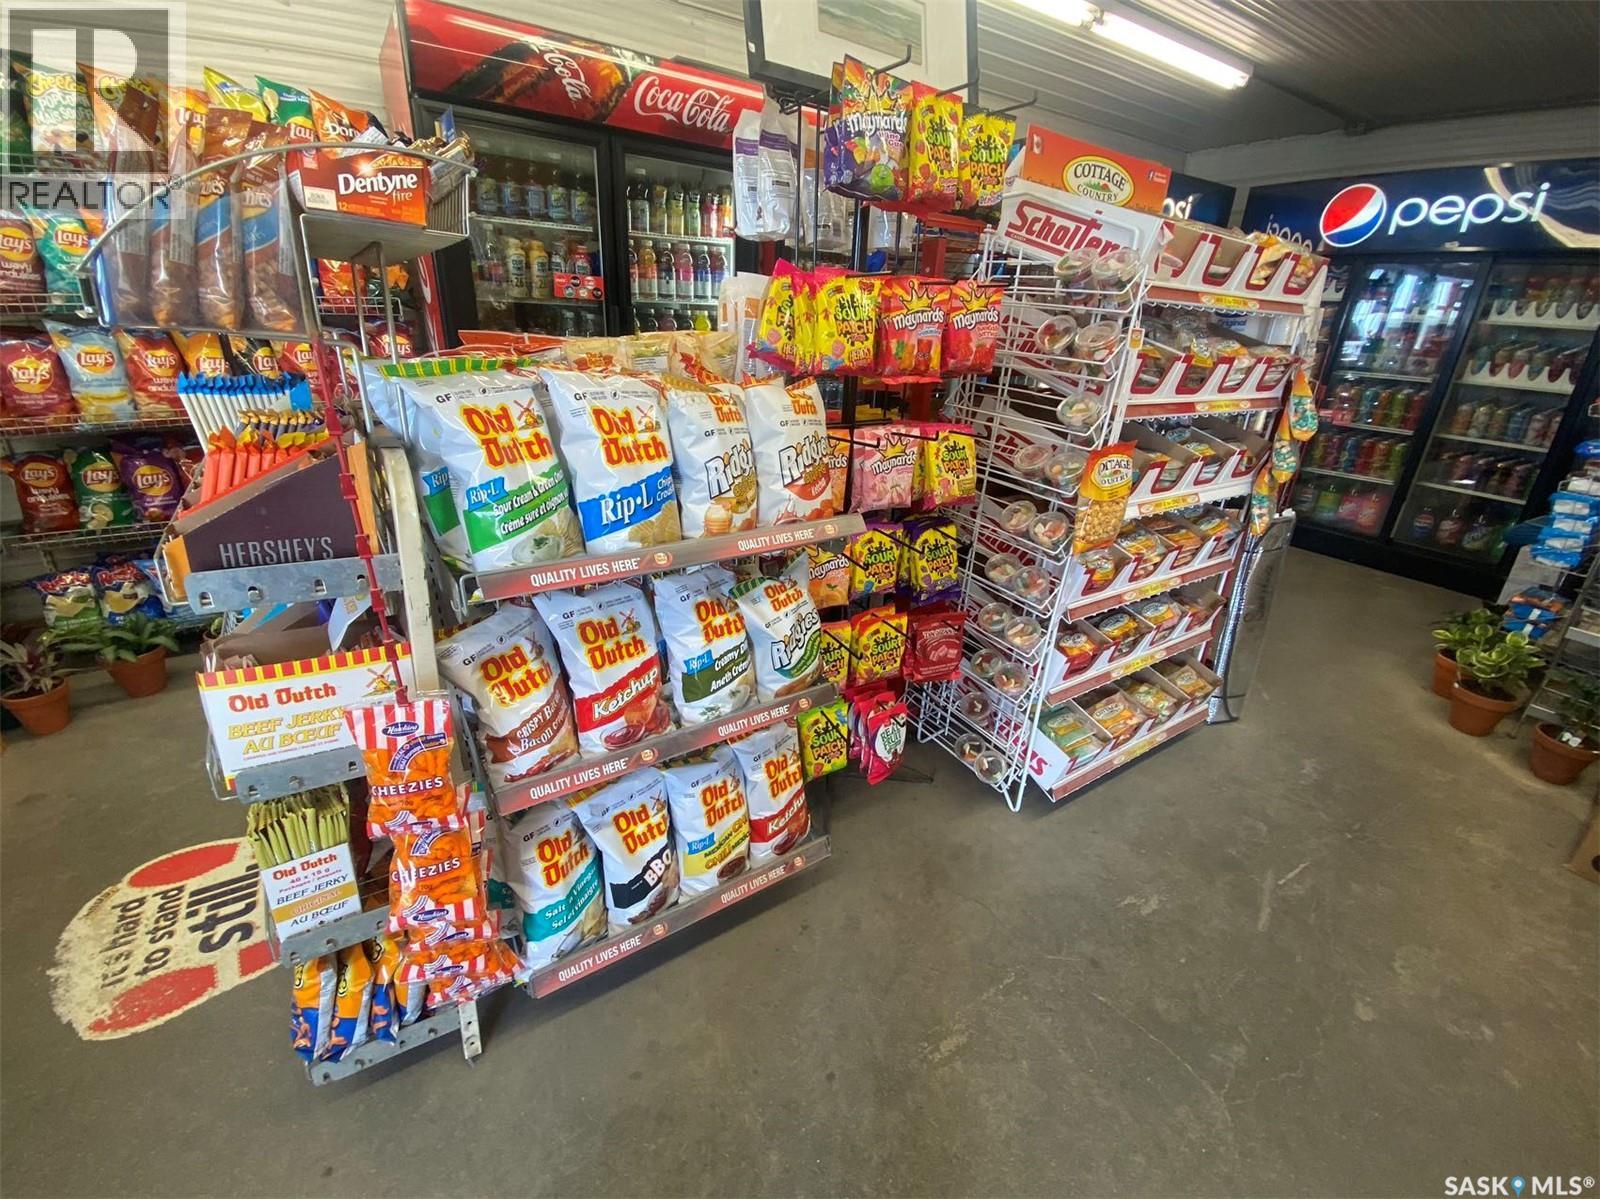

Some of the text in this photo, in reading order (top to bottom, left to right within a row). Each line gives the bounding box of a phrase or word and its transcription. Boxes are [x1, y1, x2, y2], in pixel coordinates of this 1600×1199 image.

[337, 171, 419, 196] Dentyne
[1073, 162, 1128, 192] COTTAGE
[392, 190, 413, 205] fire
[1388, 181, 1551, 236] pepsi
[436, 391, 453, 404] GF
[462, 404, 515, 437] Old
[592, 406, 638, 437] Old
[480, 430, 554, 468] Dutch
[602, 435, 669, 465] Dutch
[942, 450, 968, 461] SOUR
[136, 471, 170, 490] Lay's
[219, 536, 335, 569] HERSHEY'S
[737, 535, 773, 553] QUALITY
[771, 532, 795, 546] LIVES
[925, 546, 951, 561] SOUR
[529, 564, 577, 588] QUALITY
[579, 560, 609, 577] LIVES
[763, 583, 788, 600] Old
[769, 589, 803, 613] Dutch
[562, 610, 575, 619] GF
[578, 617, 620, 645] Old
[462, 653, 477, 667] GF
[588, 636, 646, 671] Dutch
[871, 640, 899, 655] SOUR
[481, 646, 528, 682] Old
[228, 683, 337, 714] Old Dutch
[592, 668, 659, 720] Ketchup
[228, 705, 344, 741] BEEF JERKY
[516, 712, 544, 740] CRISPY
[717, 721, 750, 737] QUALITY
[749, 714, 773, 730] LIVES
[243, 734, 273, 756] AU
[519, 727, 554, 753] Bacon
[813, 739, 846, 759] PATCH
[764, 755, 789, 781] Old
[371, 776, 444, 797] CHEEZIES
[529, 775, 573, 800] QUALITY
[573, 768, 601, 787] LIVES
[702, 780, 729, 808] Old
[613, 804, 651, 834] Old
[706, 791, 746, 828] Dutch
[522, 831, 535, 843] GF
[537, 831, 574, 864] Old
[272, 853, 338, 881] Old Dutch
[391, 856, 461, 882] CHEEZIES
[542, 845, 590, 887] Dutch
[276, 873, 349, 906] BEEF JERKY
[720, 880, 749, 904] QUALITY
[749, 871, 770, 889] LIVES
[99, 896, 147, 955] hard
[290, 912, 308, 928] AU
[545, 903, 567, 920] Salt
[551, 911, 569, 929] Sel
[134, 884, 186, 977] to stand
[558, 959, 595, 983] QUALITY
[595, 947, 620, 967] LIVES
